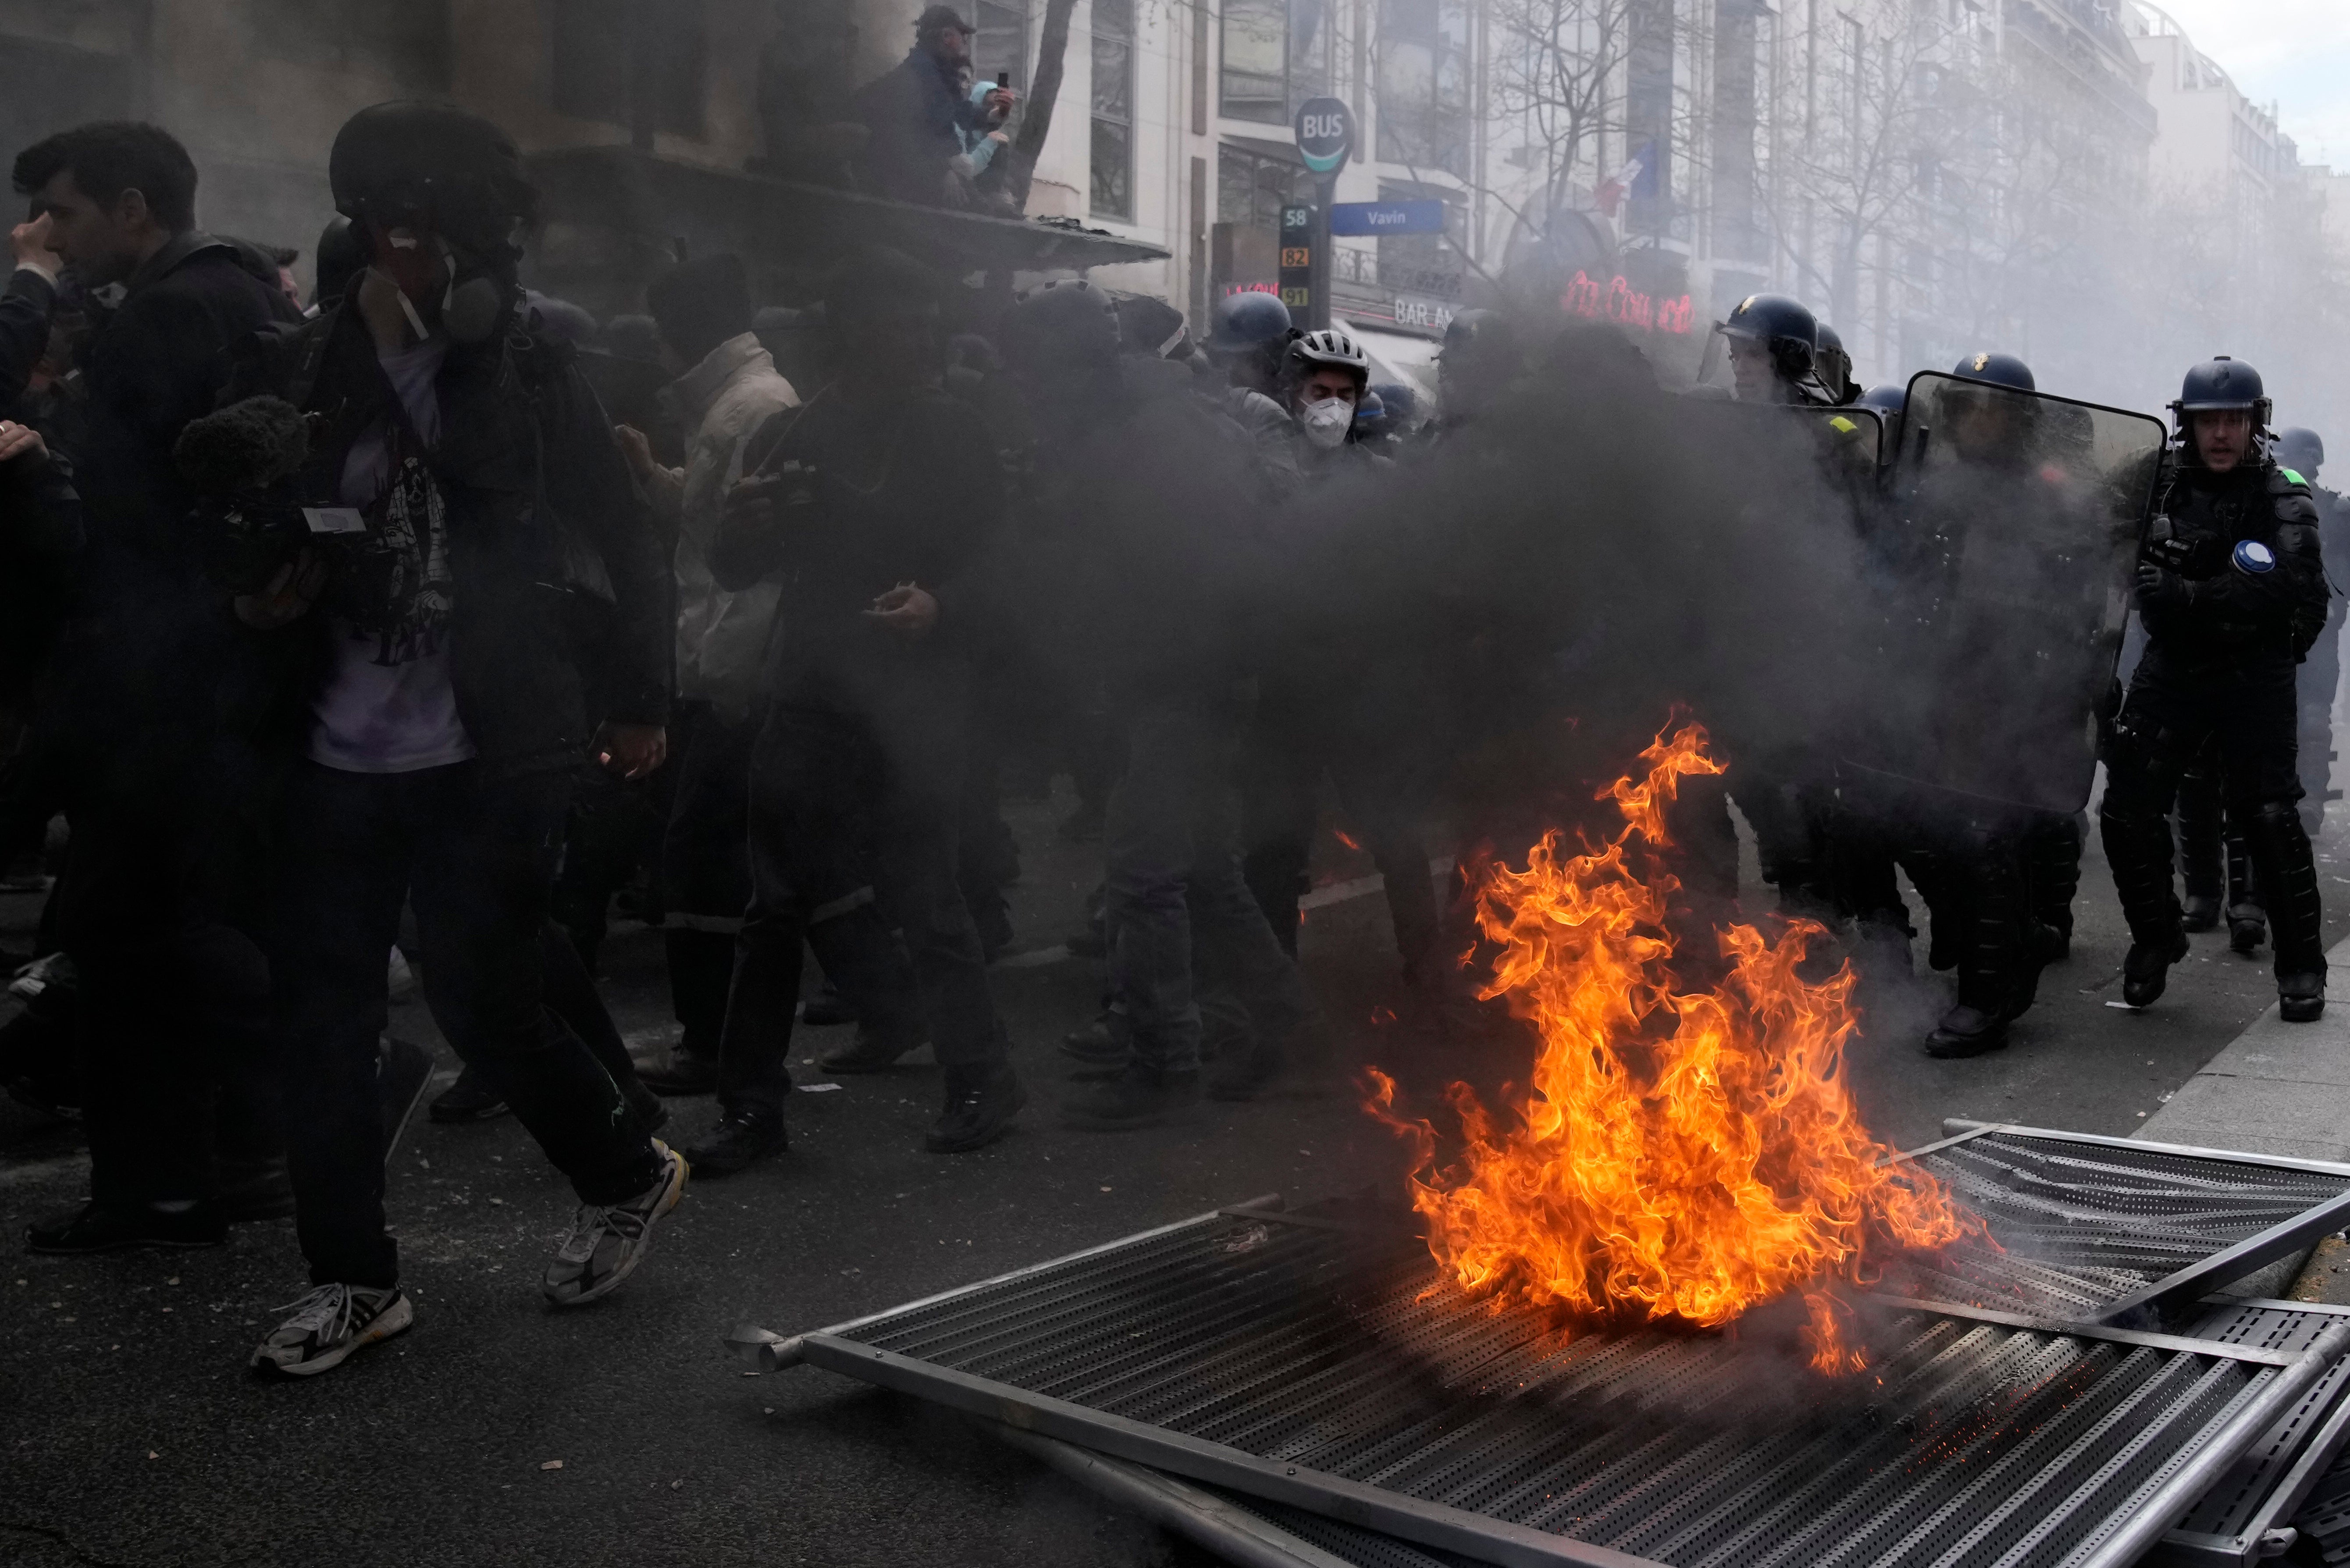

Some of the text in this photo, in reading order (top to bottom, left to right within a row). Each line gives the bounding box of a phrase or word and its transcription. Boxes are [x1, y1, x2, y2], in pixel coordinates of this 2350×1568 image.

[1303, 114, 1343, 139] BUS
[1285, 209, 1306, 226] 58
[1367, 210, 1406, 225] Vavin
[1286, 249, 1305, 264] 82
[1286, 289, 1304, 305] 91
[1394, 299, 1428, 325] BAR
